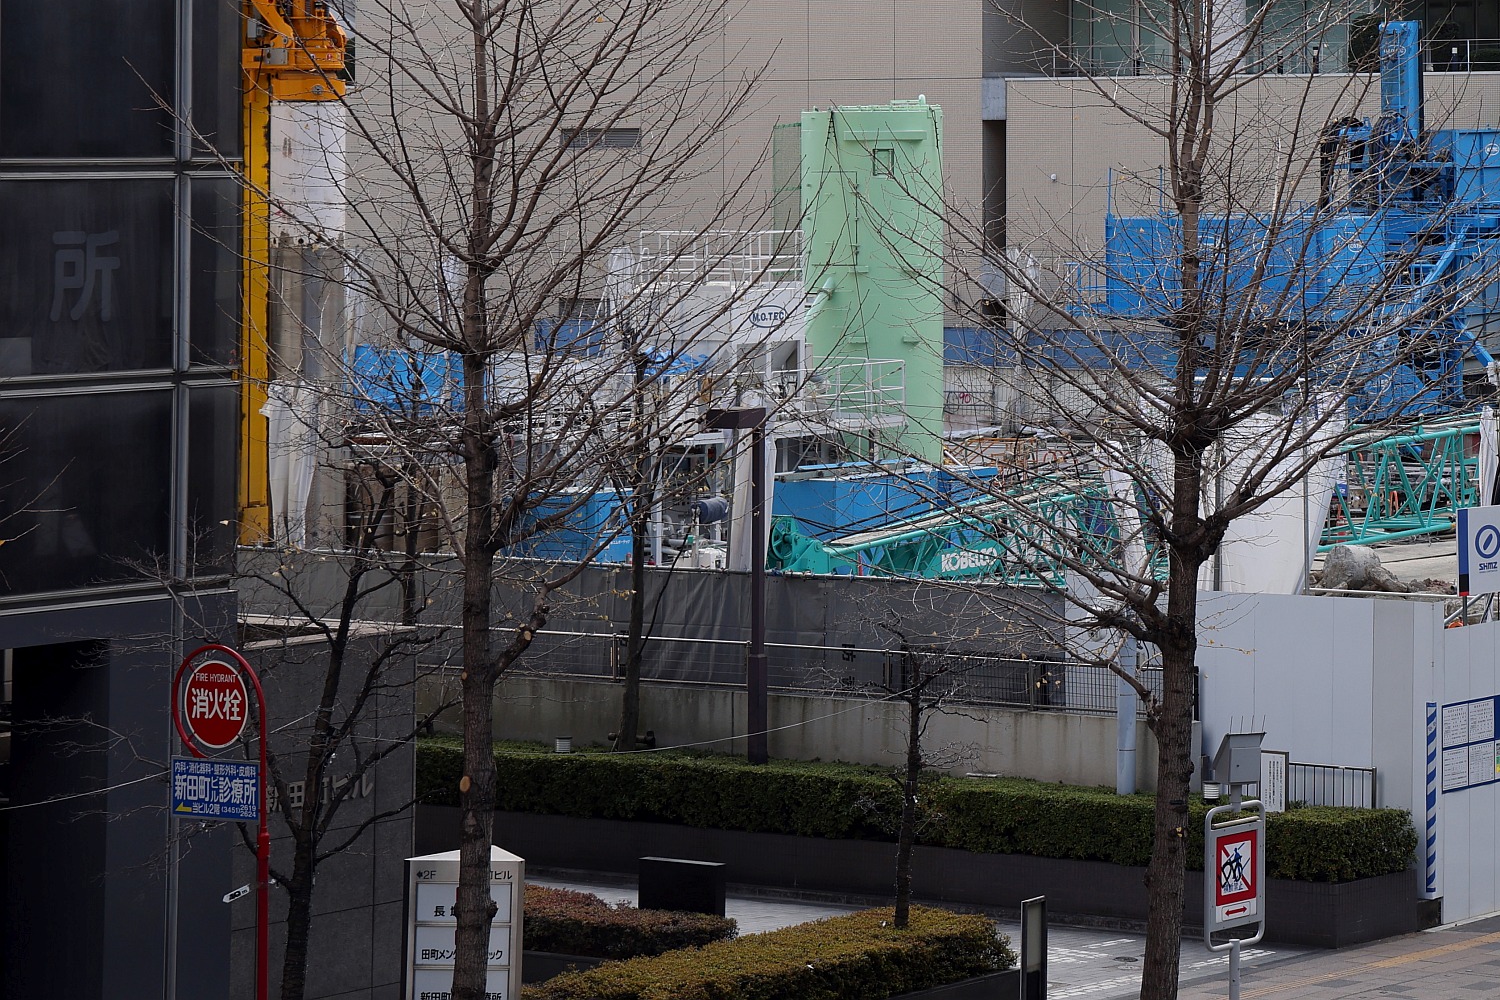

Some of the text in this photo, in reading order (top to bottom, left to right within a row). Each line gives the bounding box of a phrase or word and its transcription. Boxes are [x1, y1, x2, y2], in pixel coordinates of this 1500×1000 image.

[50, 230, 121, 322] 所
[941, 547, 998, 573] KOBELCO
[196, 673, 236, 683] FIRE HYDRANT
[191, 687, 242, 721] 消火栓
[174, 774, 257, 805] 新田町ビル診療所
[192, 802, 220, 815] 当ビル2階
[423, 870, 437, 880] 2F
